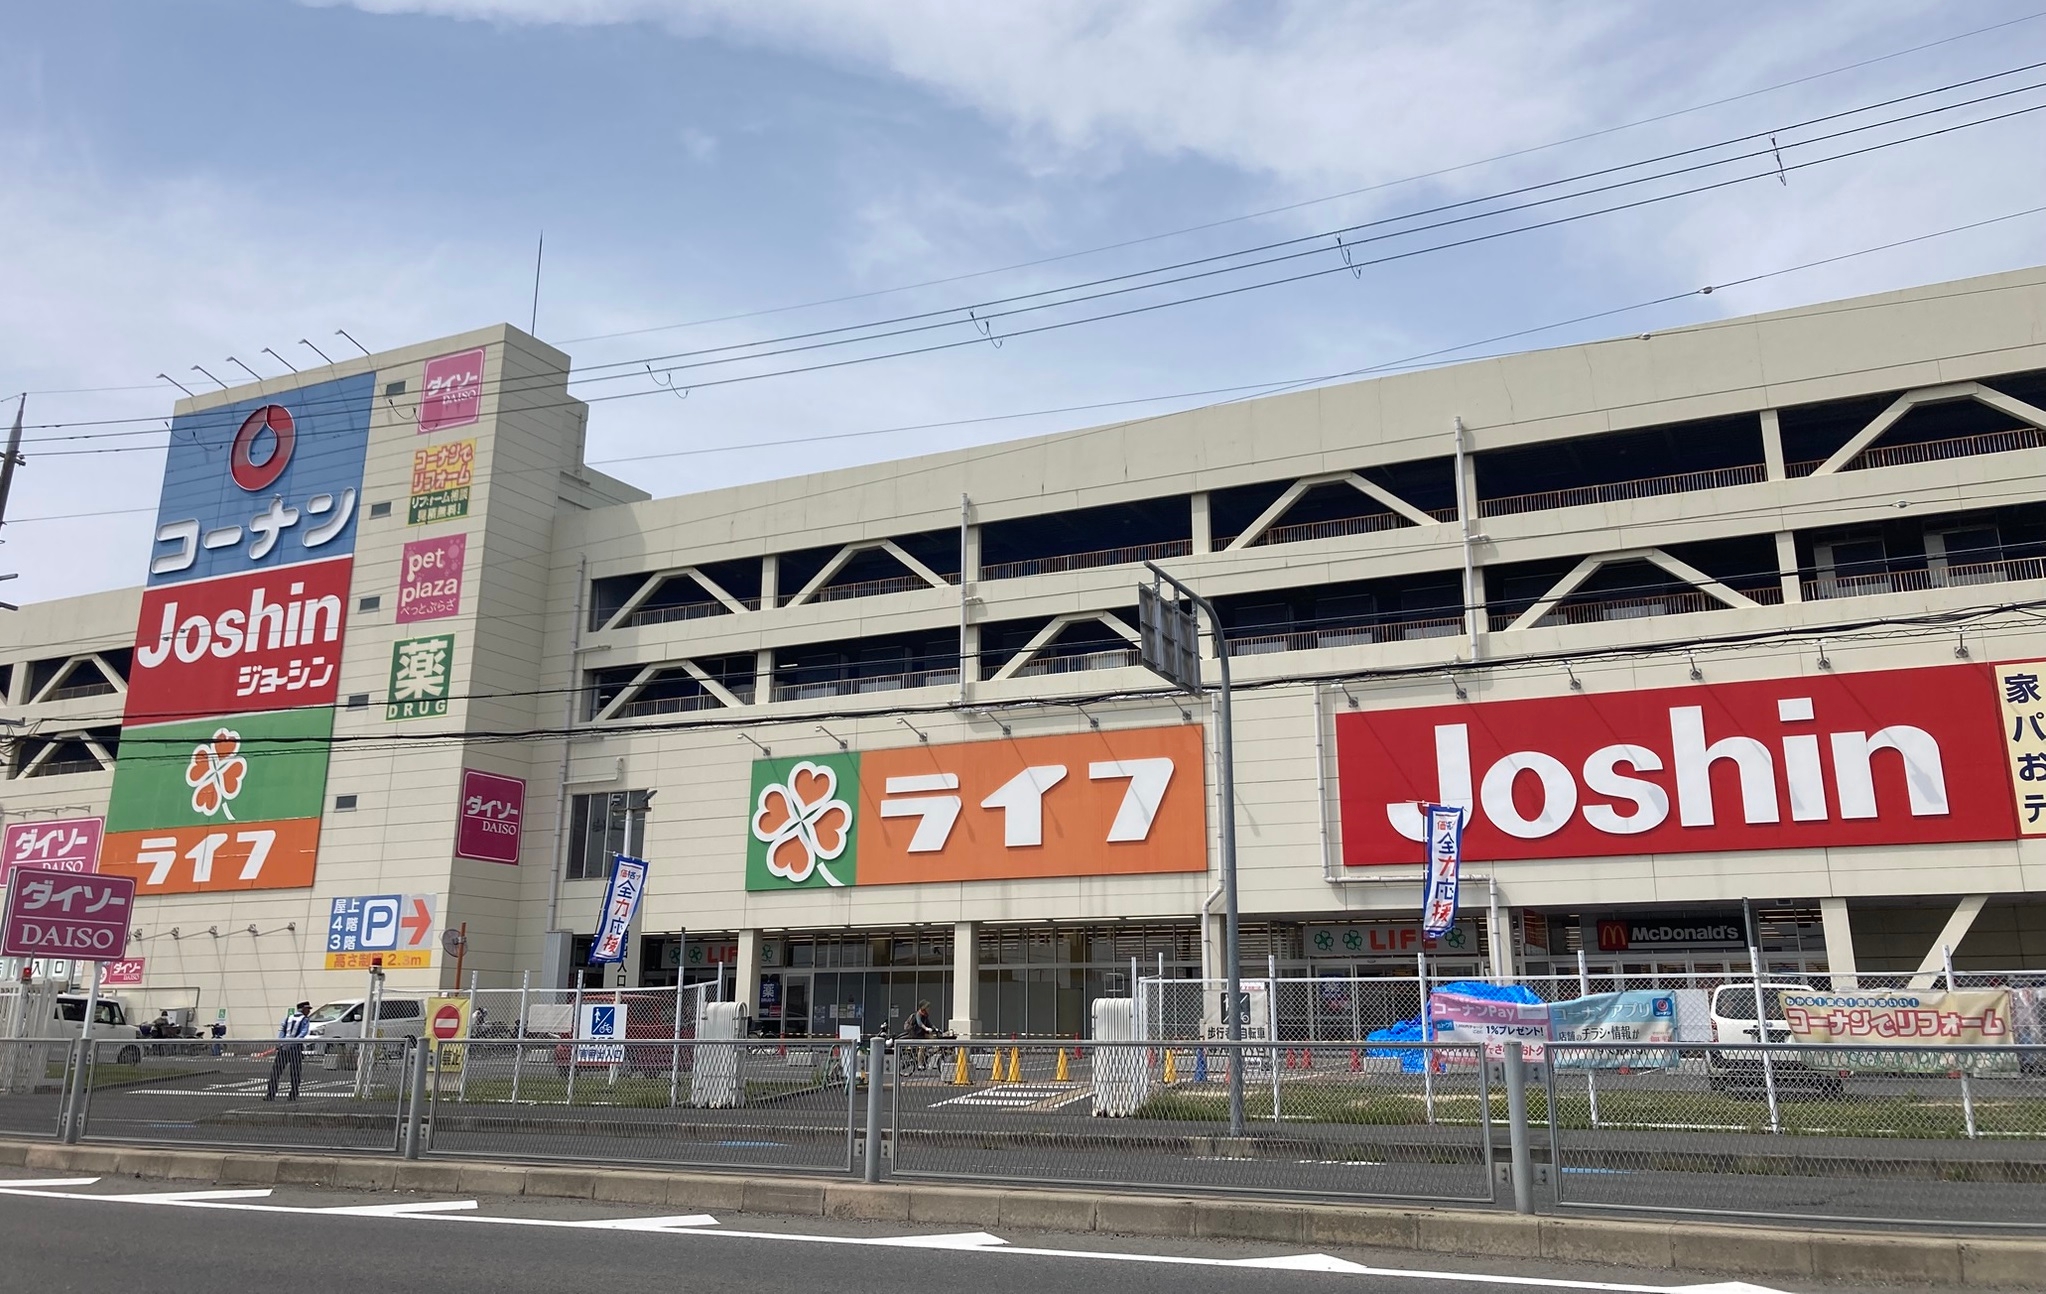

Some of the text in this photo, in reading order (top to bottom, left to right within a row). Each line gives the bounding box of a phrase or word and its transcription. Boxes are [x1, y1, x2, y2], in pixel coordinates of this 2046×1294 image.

[427, 372, 478, 396] ダイソー
[442, 390, 477, 404] DAISO
[414, 442, 474, 471] コーナンで
[411, 463, 471, 494] リフォーム
[151, 487, 356, 574] コーナン
[406, 548, 445, 582] pet
[401, 578, 458, 607] plaza
[137, 582, 341, 668] Joshin
[237, 656, 334, 696] ジョーシン
[395, 639, 448, 701] 薬
[388, 700, 446, 718] DRUG
[1386, 697, 1950, 842] Joshin
[466, 795, 518, 819] ダイソー
[881, 757, 1174, 853] ライフ
[482, 821, 517, 836] DAISO
[15, 828, 88, 860] ダイソー
[137, 830, 277, 885] ライフ
[1432, 832, 1456, 923] 全力応援
[22, 879, 126, 913] ダイソー
[334, 898, 361, 914] 屋上
[332, 916, 359, 932] 4階
[603, 879, 636, 954] 全力応援
[19, 924, 114, 949] DAISO
[329, 934, 357, 950] 3階
[1632, 925, 1739, 941] McDonald's
[113, 962, 141, 974] ダイソー
[1434, 1002, 1515, 1021] コーナンPay
[1553, 1001, 1650, 1021] コーナンアプリ
[1786, 1008, 2006, 1038] コーナンでリフォーム
[1486, 1025, 1544, 1036] 1%プレゼント!
